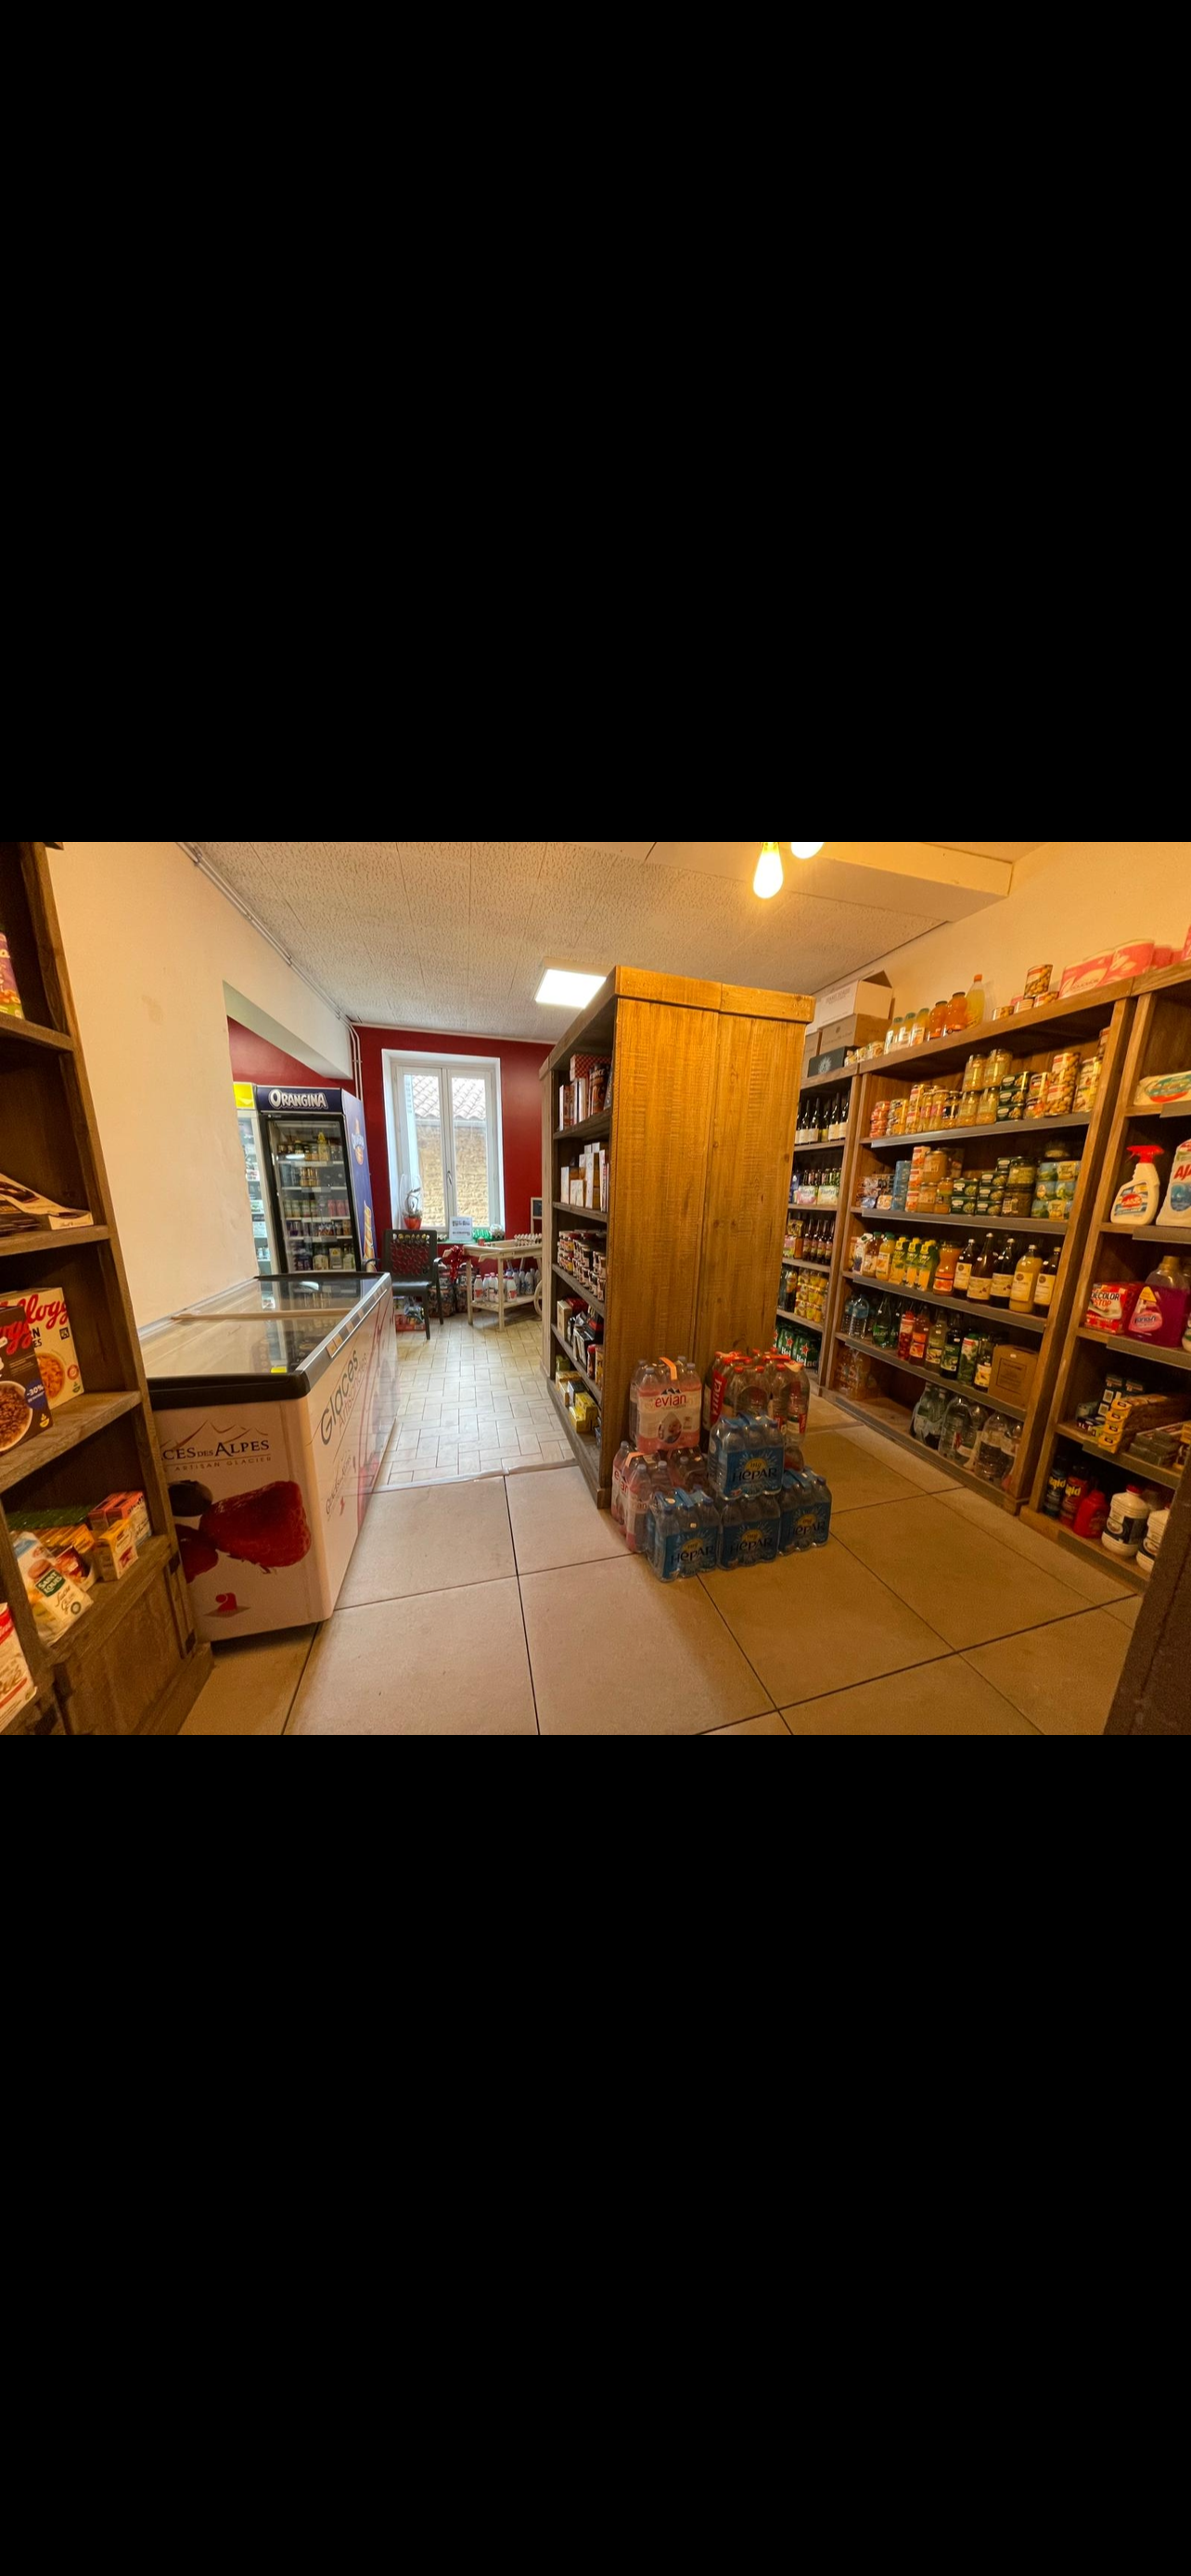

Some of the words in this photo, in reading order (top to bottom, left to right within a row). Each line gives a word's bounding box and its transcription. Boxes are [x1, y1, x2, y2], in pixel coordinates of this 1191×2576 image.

[269, 1089, 327, 1108] ORANGINA
[655, 1394, 686, 1408] evian
[160, 1447, 196, 1460] CES
[214, 1440, 270, 1458] ALPES
[174, 1461, 220, 1472] ARTISAN
[226, 1456, 272, 1466] GLACIER
[38, 1571, 58, 1589] SAINT
[44, 1575, 62, 1594] LOUIS
